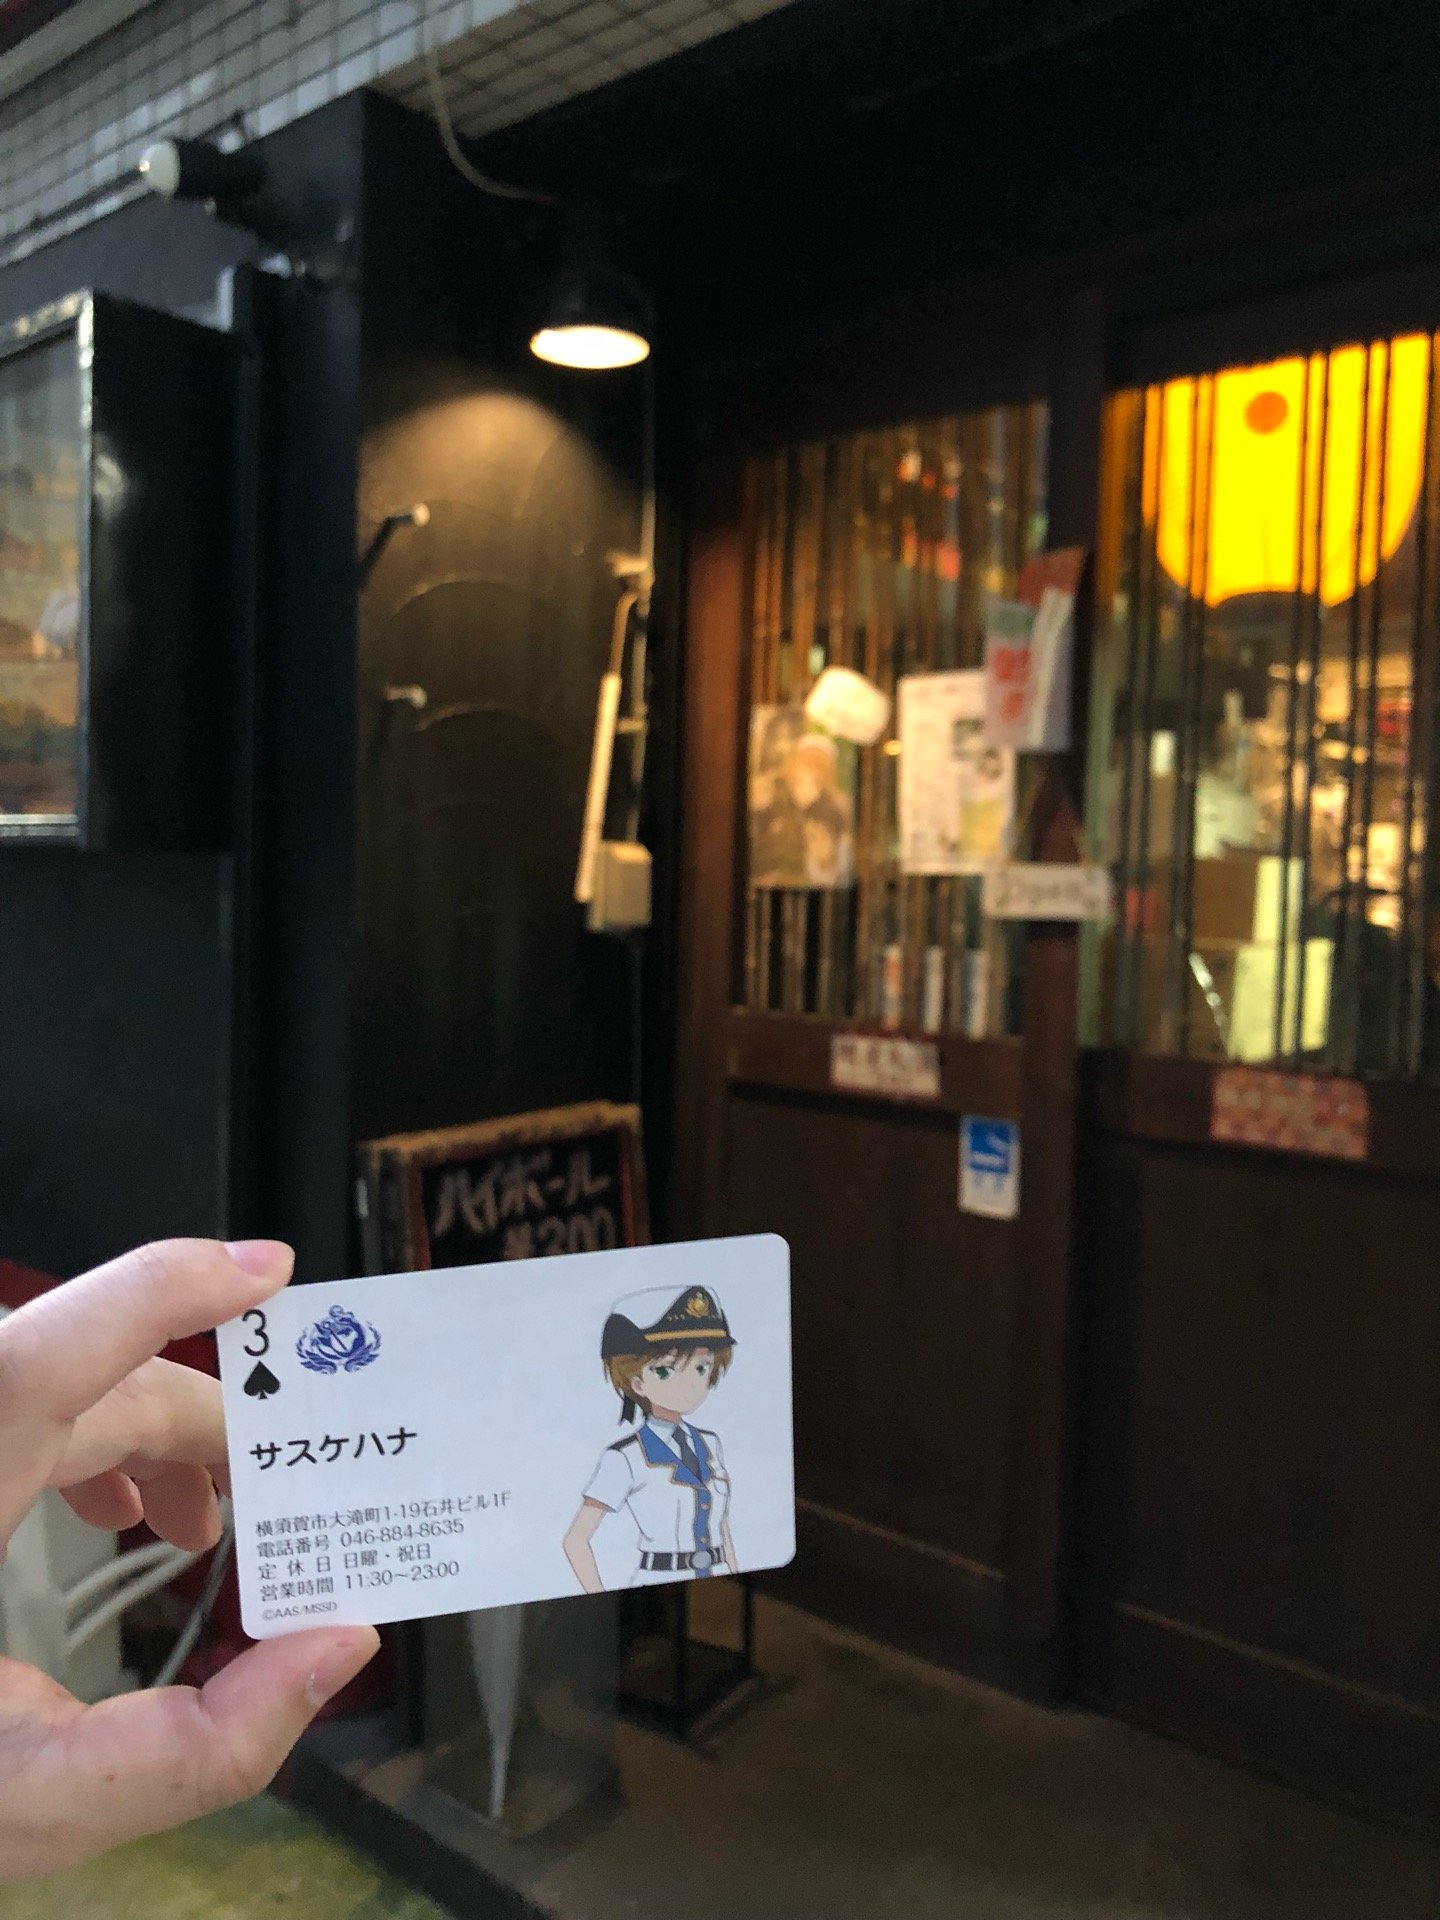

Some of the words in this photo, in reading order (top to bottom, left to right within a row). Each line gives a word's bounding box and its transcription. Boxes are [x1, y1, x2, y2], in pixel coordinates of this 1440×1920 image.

[433, 1148, 614, 1239] ハイボール
[242, 1309, 269, 1356] 3
[249, 1427, 417, 1470] サスケハナ
[257, 1534, 330, 1558] 電話番号
[340, 1518, 465, 1547] 046-884-8635
[260, 1577, 334, 1602] 営業時間
